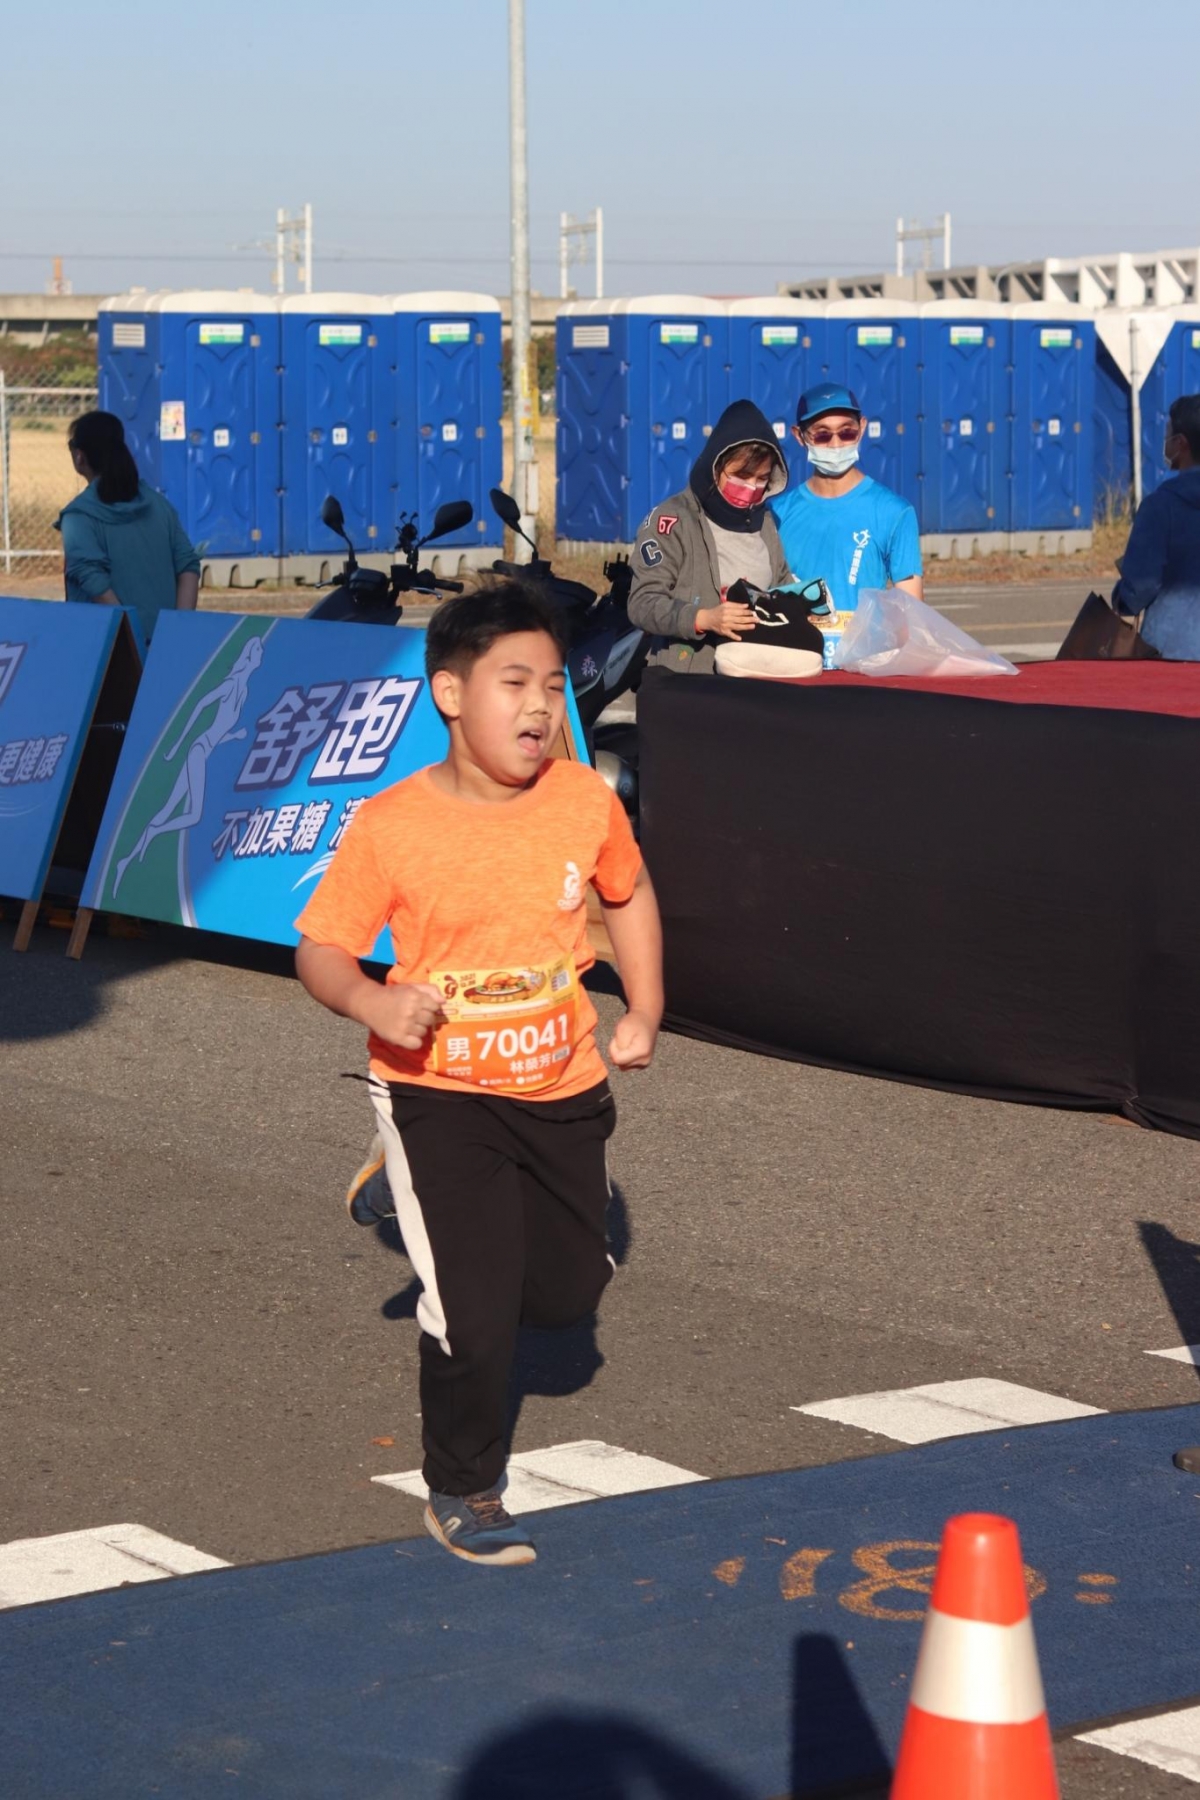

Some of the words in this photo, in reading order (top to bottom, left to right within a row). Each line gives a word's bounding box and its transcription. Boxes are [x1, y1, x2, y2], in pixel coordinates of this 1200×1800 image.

[639, 538, 664, 568] C
[581, 655, 598, 677] 森
[234, 676, 423, 788] 舒跑
[0, 734, 68, 785] 更健康
[212, 800, 332, 859] 不加果糖
[446, 1037, 471, 1062] 男
[475, 1013, 568, 1061] 70041
